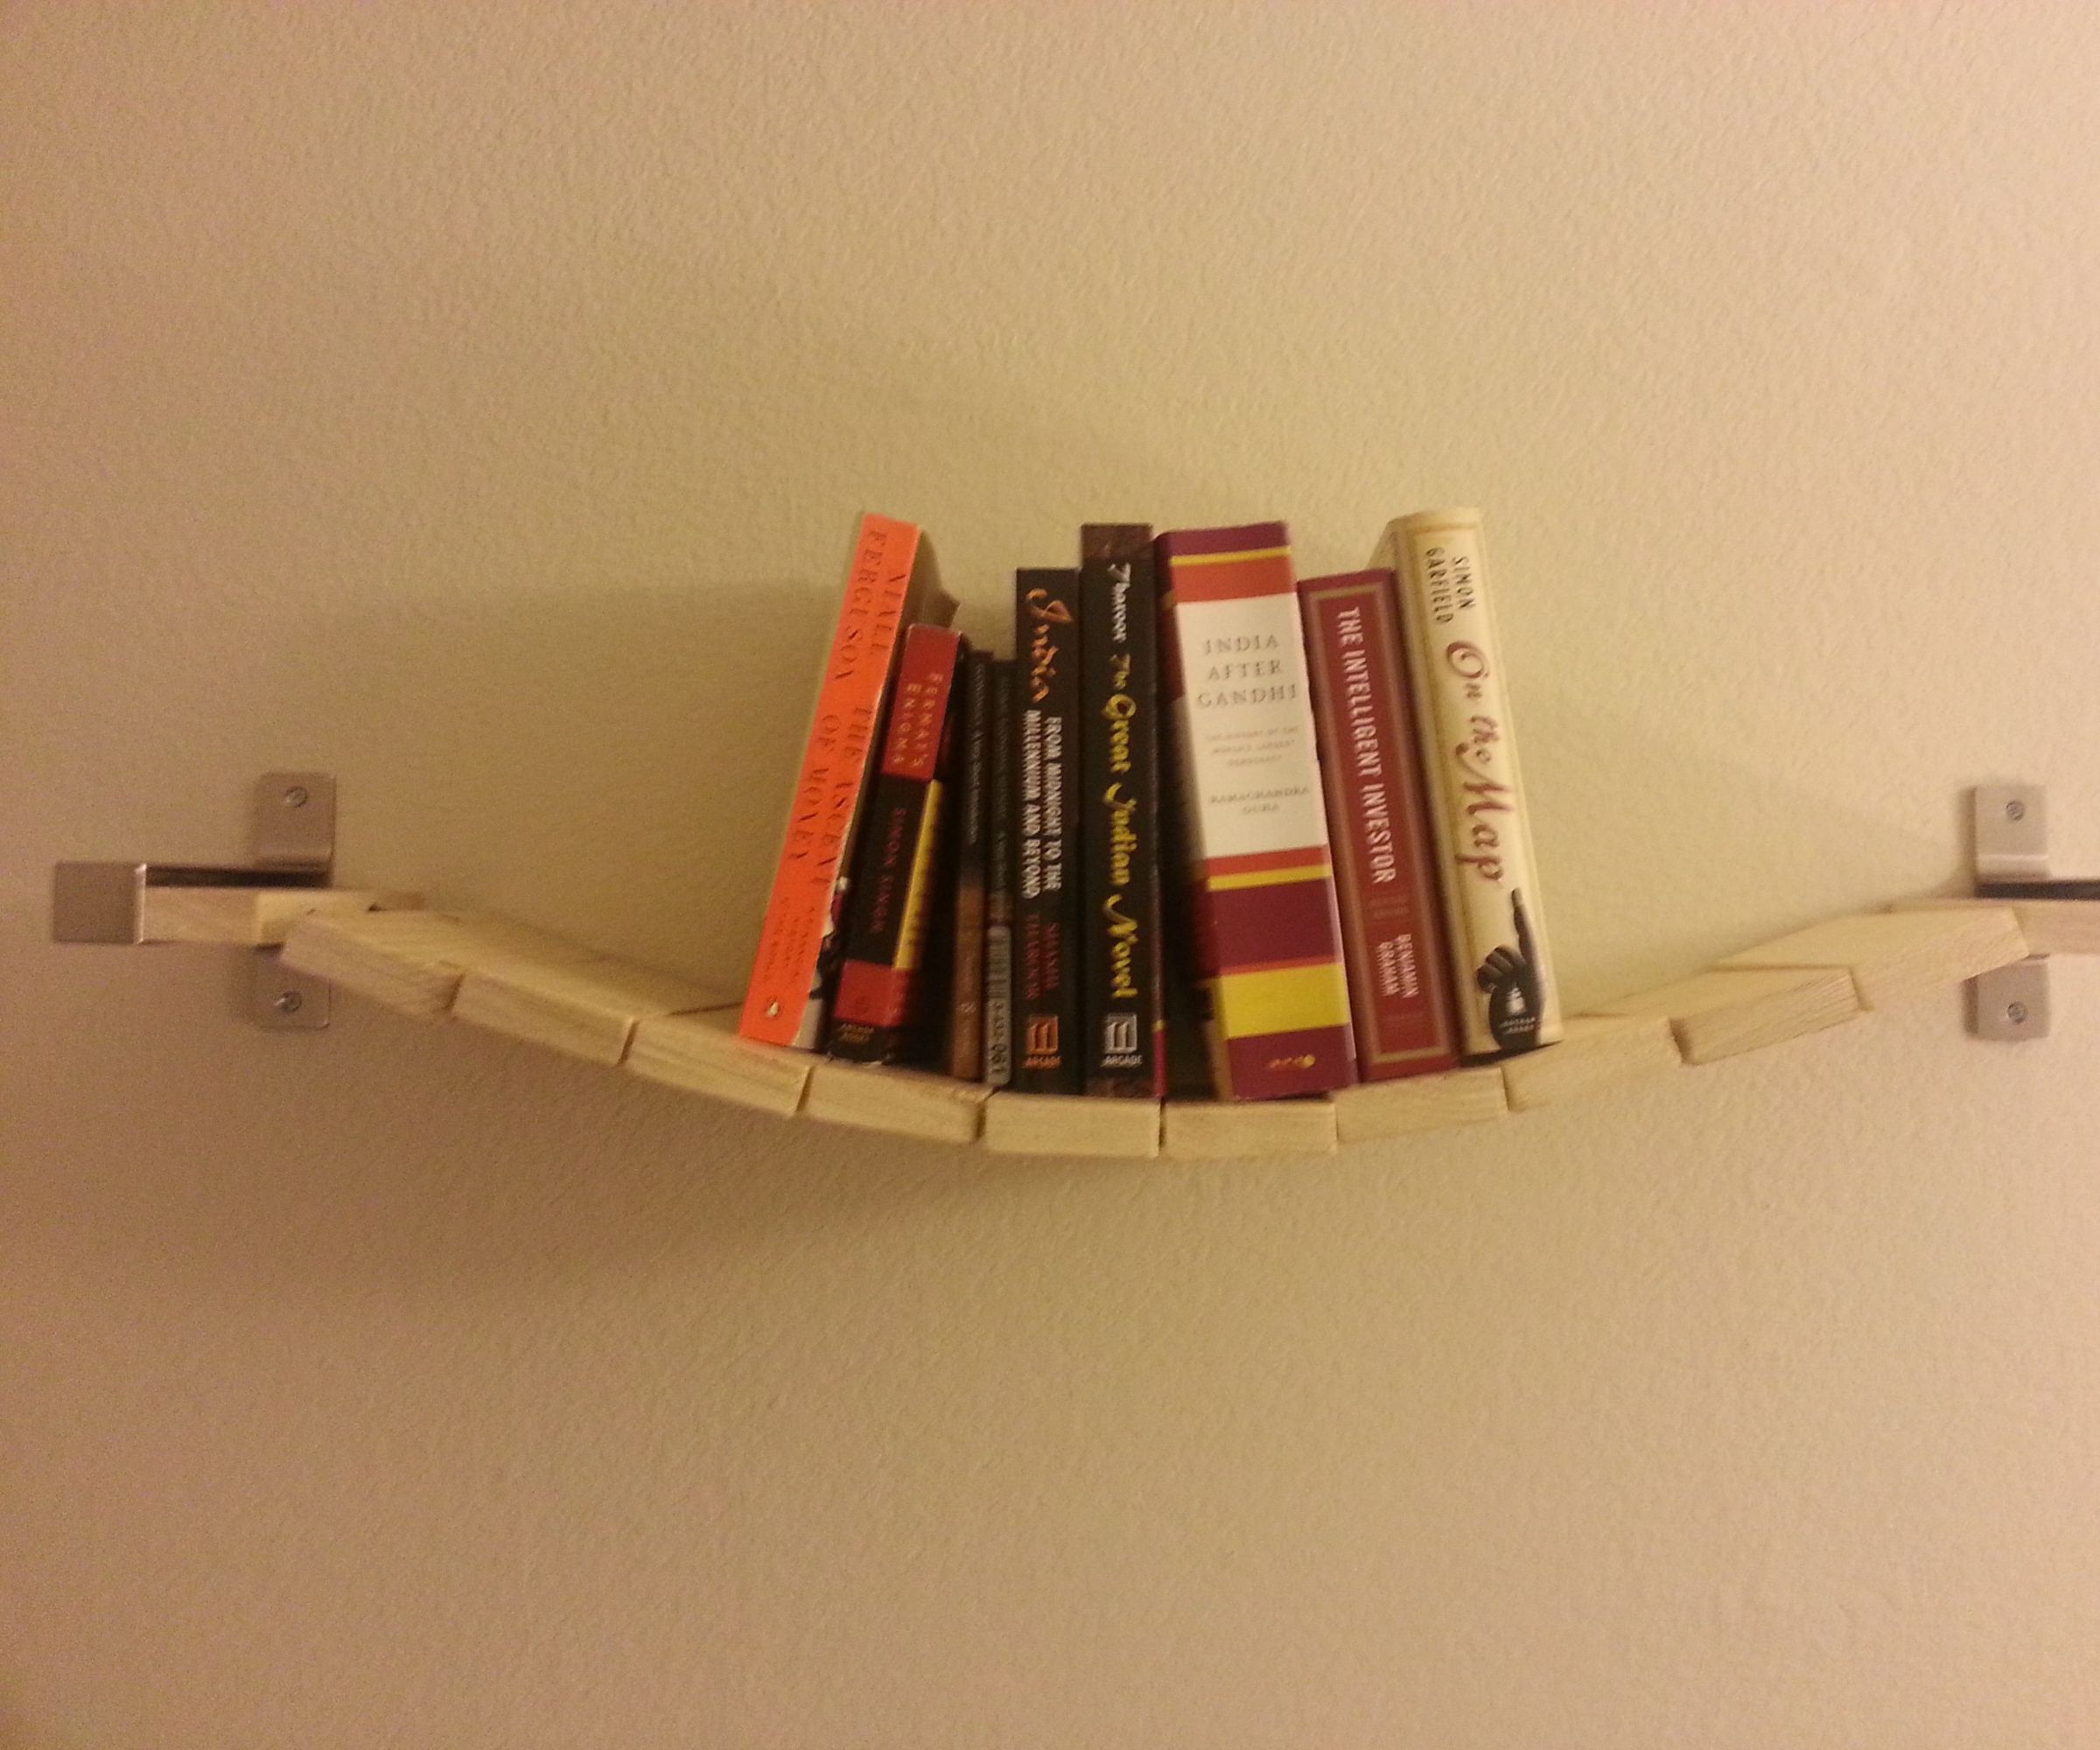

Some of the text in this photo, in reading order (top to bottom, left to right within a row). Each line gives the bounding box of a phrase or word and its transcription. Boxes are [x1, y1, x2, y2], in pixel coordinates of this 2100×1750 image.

[832, 530, 887, 682] FERGUSON
[870, 573, 908, 656] NIALL
[1426, 547, 1455, 625] GARFIELD
[1452, 555, 1476, 611] SIMON
[1026, 587, 1076, 703] India
[1204, 634, 1279, 655] INDIA
[1338, 606, 1364, 647] THE
[1197, 683, 1298, 708] GANDHI
[1207, 659, 1283, 681] AFTER
[817, 714, 841, 752] OF
[891, 682, 923, 766] ENIGMA
[1102, 694, 1138, 774] Great
[1342, 649, 1382, 777] INTELLIGENT
[808, 707, 873, 887] THE ASCENT
[1446, 640, 1515, 882] On the Map
[787, 767, 830, 861] MONEY
[1020, 710, 1042, 899] MILLENNIUM AND BEYOND
[1041, 716, 1063, 891] FROM MIDNIGHT TO THE
[1102, 782, 1138, 886] Indian
[1361, 783, 1397, 884] INVESTOR
[1103, 894, 1138, 998] Novel
[1376, 941, 1400, 998] GRAHAM
[1395, 933, 1419, 999] BENJAMIN
[1100, 1054, 1143, 1068] ARCADE
